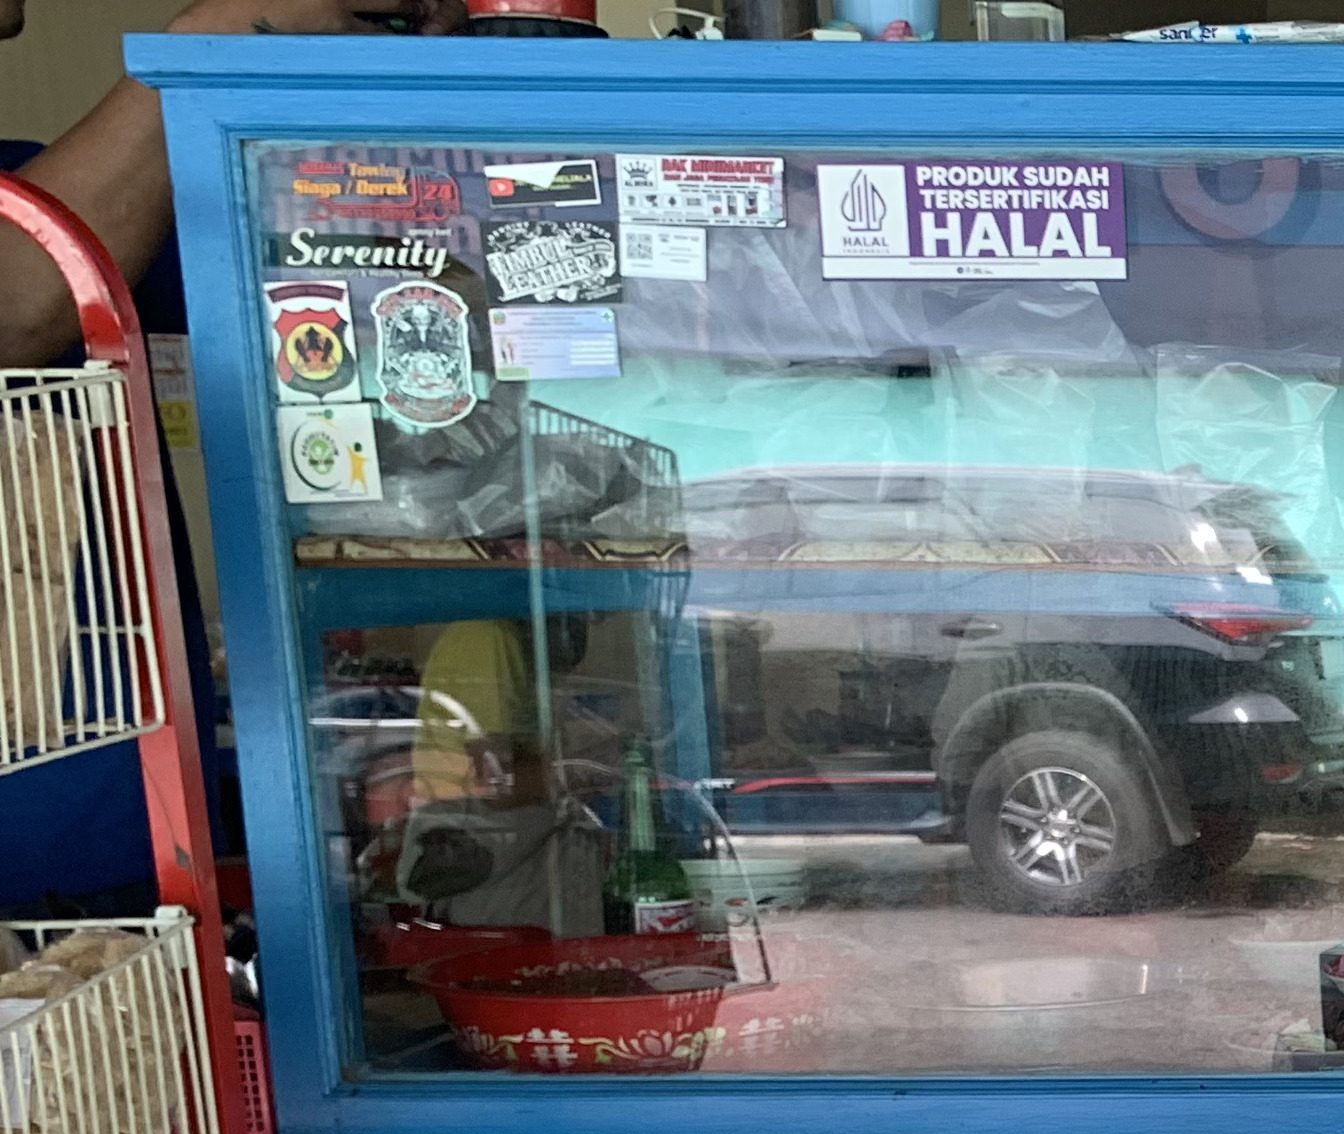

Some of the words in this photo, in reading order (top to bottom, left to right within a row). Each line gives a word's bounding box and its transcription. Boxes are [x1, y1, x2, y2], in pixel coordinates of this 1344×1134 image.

[1159, 24, 1218, 40] sanier
[916, 166, 1018, 187] PRODUK
[1023, 166, 1109, 187] SUDAH
[355, 179, 409, 196] Derek
[919, 189, 1109, 210] TERSERTIFIKASI
[843, 236, 889, 247] HALAL
[920, 212, 1112, 257] HALAL
[285, 227, 449, 278] Serenity
